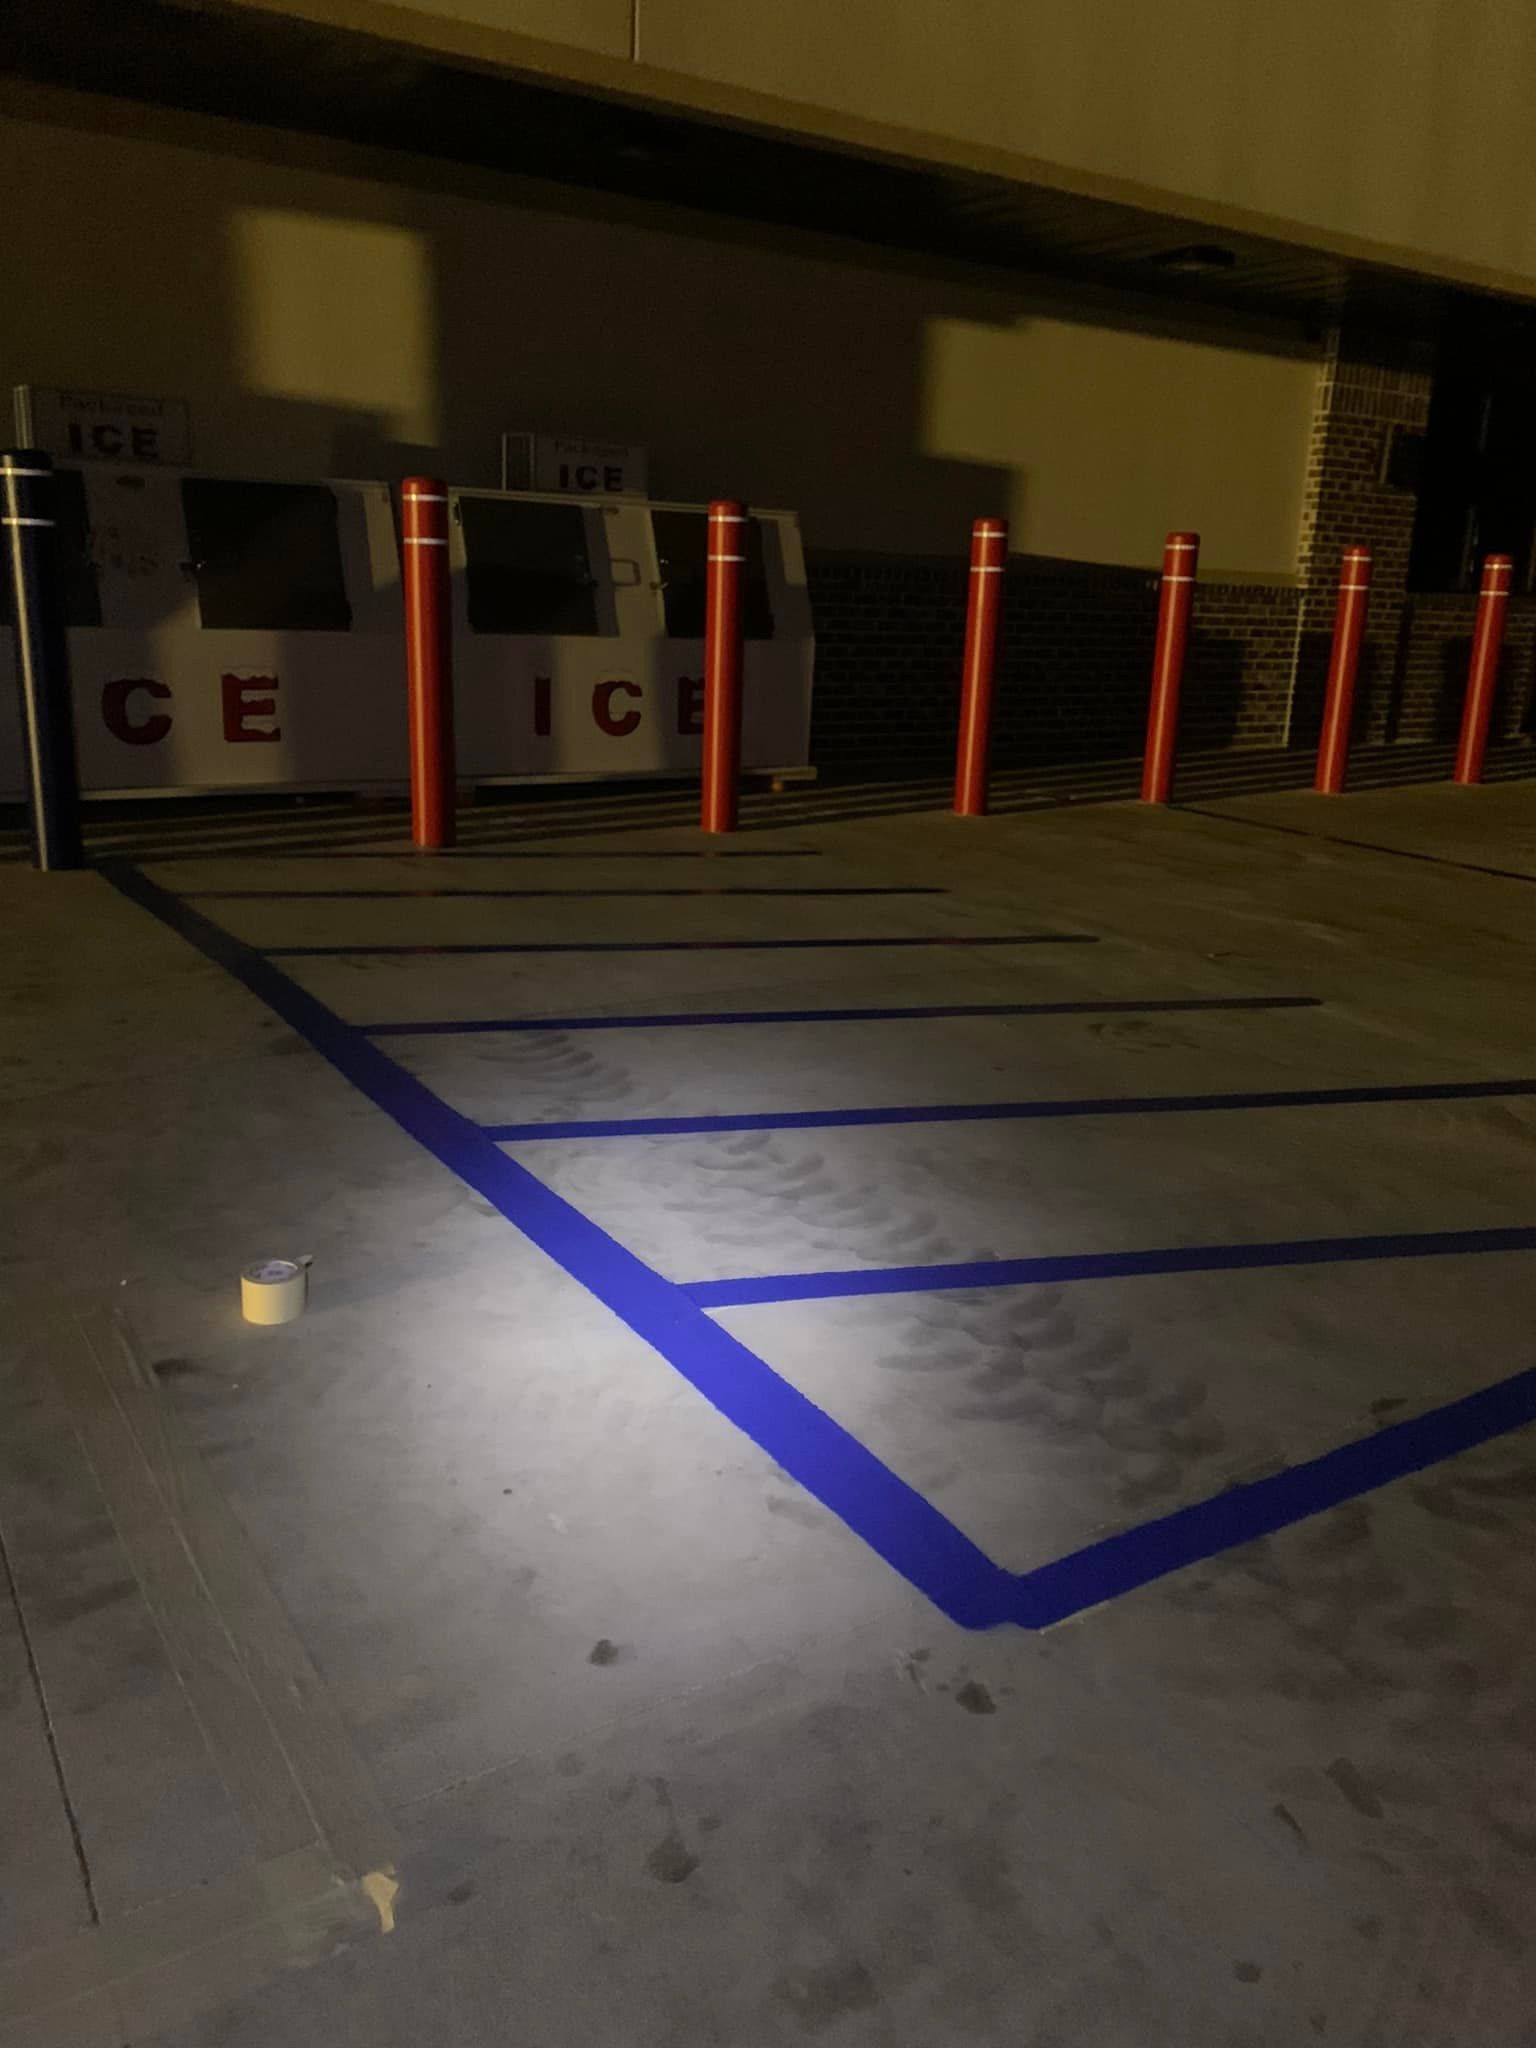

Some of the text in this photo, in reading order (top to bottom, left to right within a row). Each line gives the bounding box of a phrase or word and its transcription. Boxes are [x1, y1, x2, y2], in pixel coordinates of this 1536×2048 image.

[68, 423, 158, 458] ICE
[559, 463, 624, 492] ICE
[101, 673, 281, 745] CE
